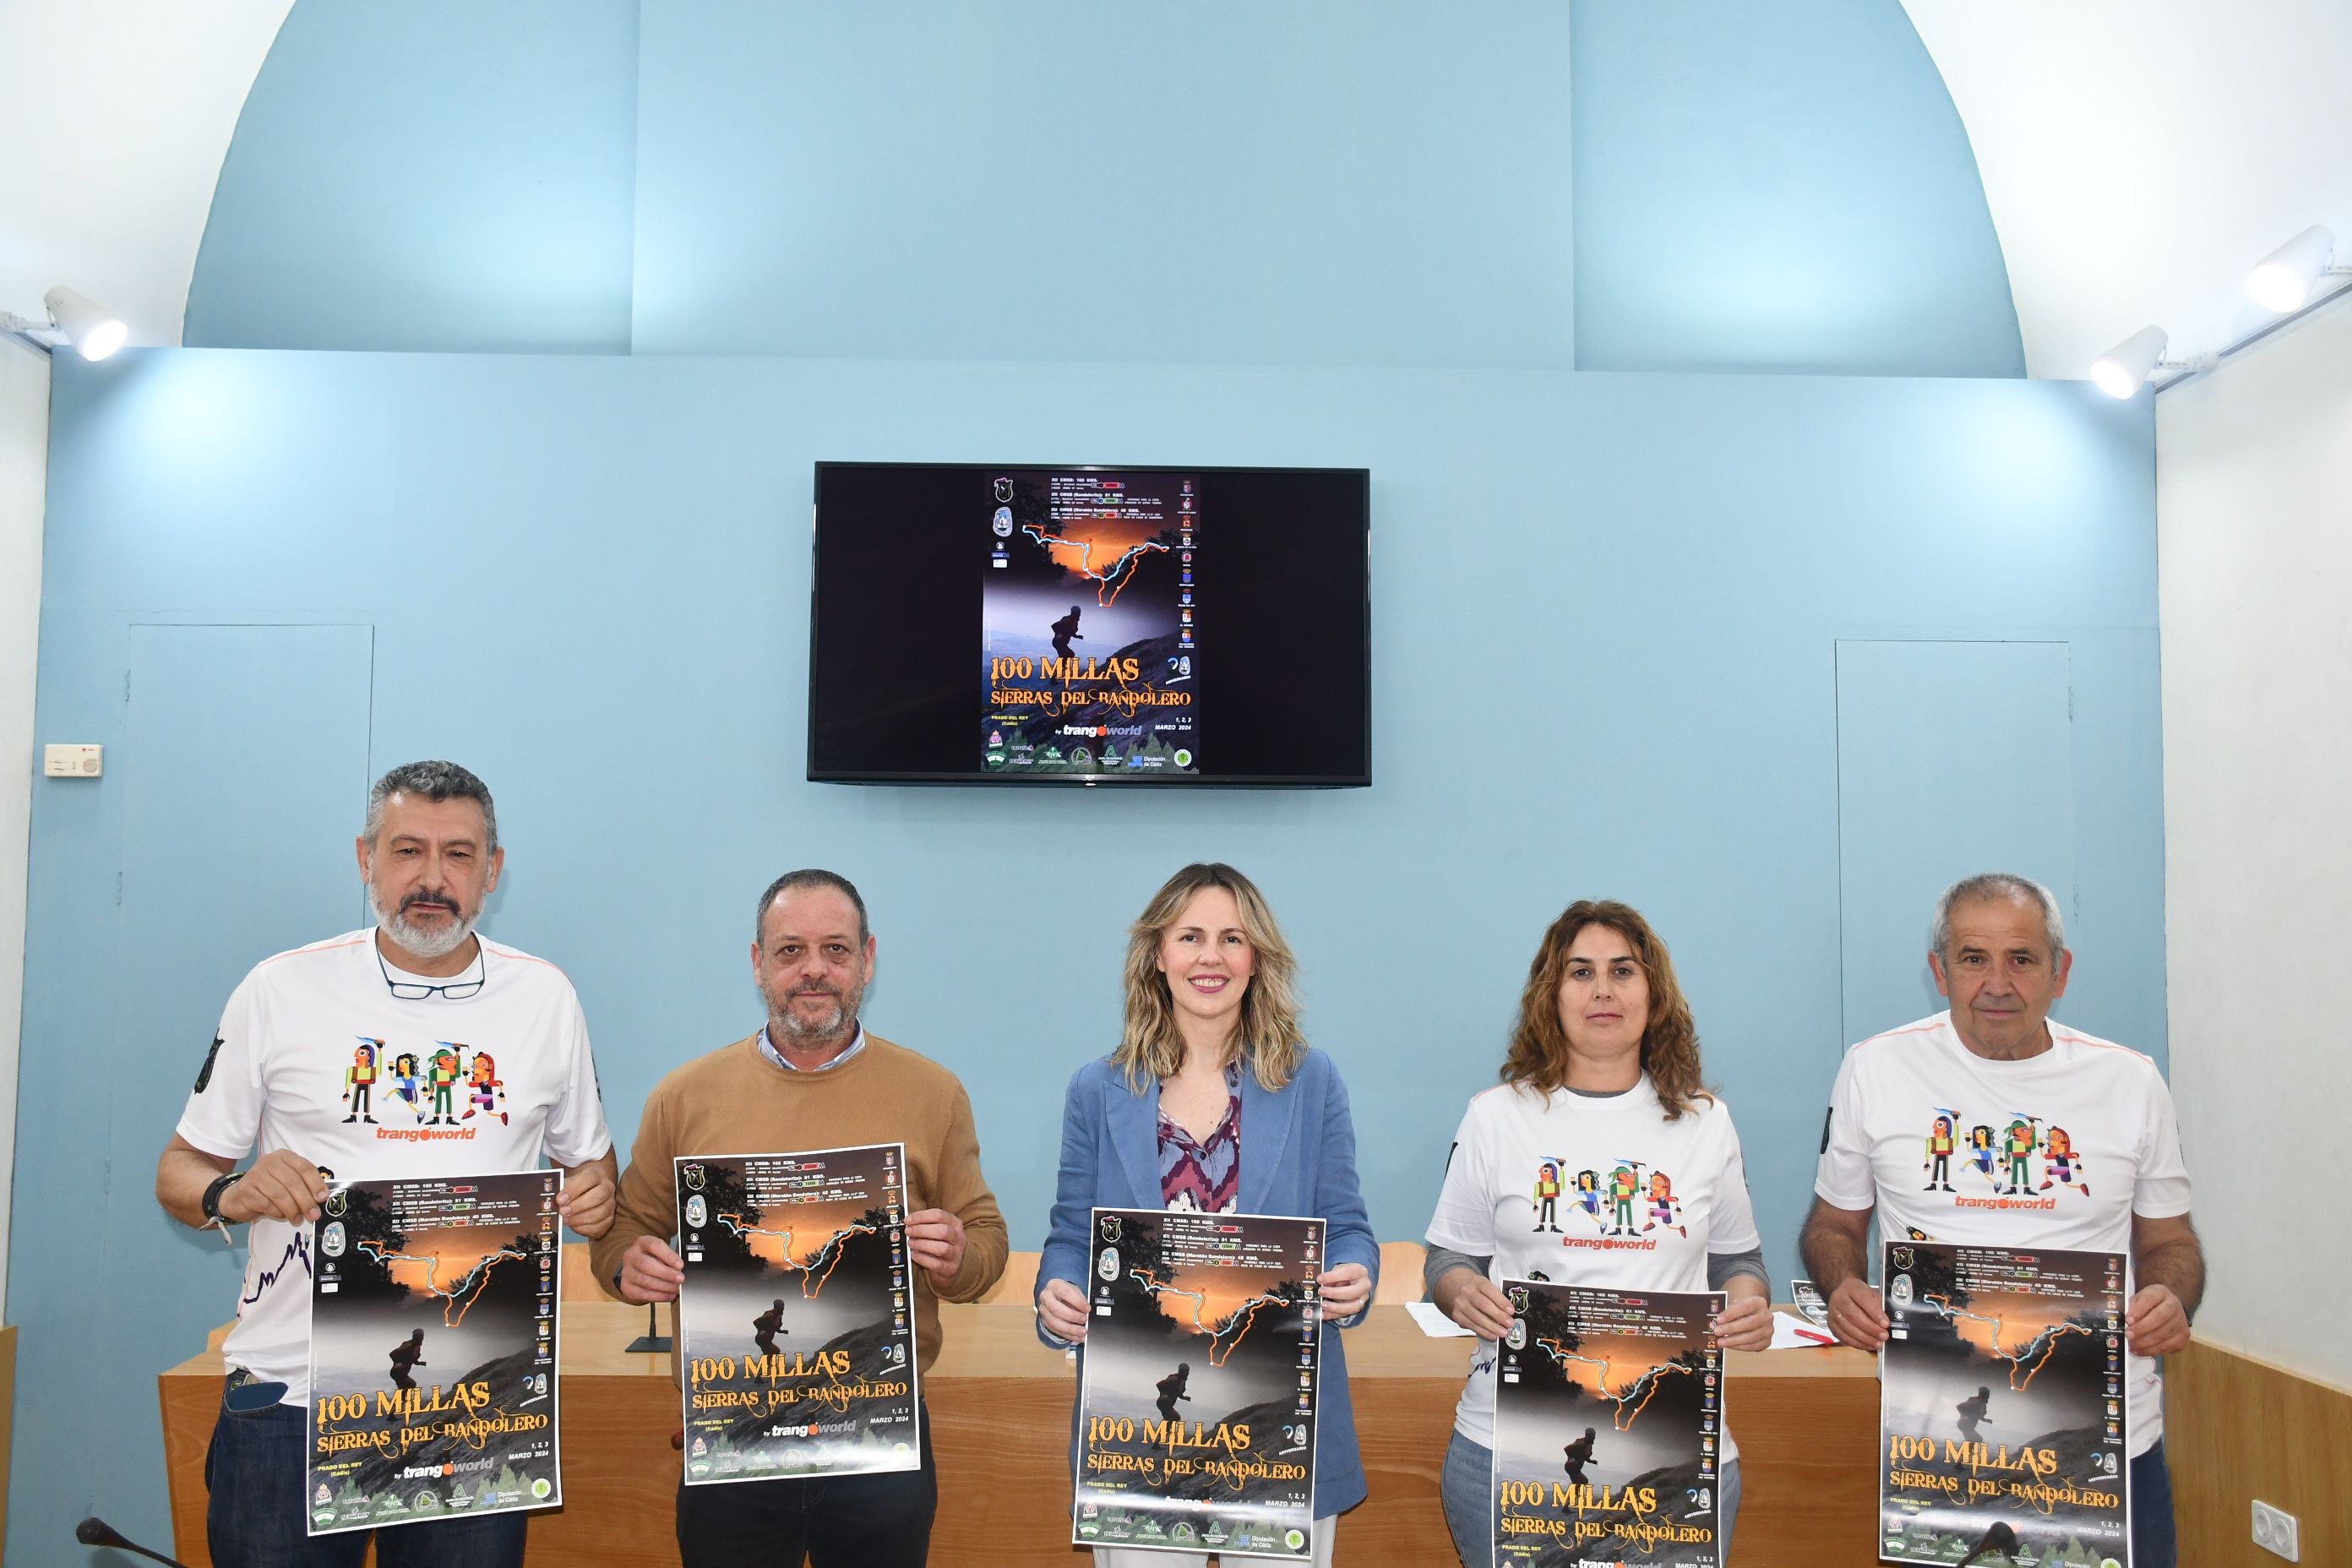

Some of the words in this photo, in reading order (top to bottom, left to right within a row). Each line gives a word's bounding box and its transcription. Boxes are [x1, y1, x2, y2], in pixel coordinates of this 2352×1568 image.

[991, 656, 1033, 679] 100
[1040, 656, 1139, 688] MILLAS
[991, 690, 1055, 712] SIERRAS
[1061, 691, 1090, 710] DEL
[1098, 687, 1191, 712] BANDOLERO
[1063, 725, 1142, 738] trangoworld
[376, 1127, 476, 1142] trangoworld
[1955, 1195, 2056, 1210] trangoworld
[1562, 1236, 1657, 1250] trangoworld
[690, 1356, 736, 1383] 100
[743, 1350, 851, 1387] MILLAS
[317, 1393, 368, 1425] 100
[376, 1381, 490, 1425] MILLAS
[693, 1391, 762, 1415] SIERRAS
[768, 1389, 800, 1412] DEL
[807, 1377, 907, 1407] BANDOLERO
[317, 1430, 395, 1458] SIERRAS
[400, 1426, 435, 1451] DEL
[440, 1409, 548, 1446] BANDOLERO
[771, 1420, 857, 1437] trangoworld
[1088, 1416, 1135, 1442] 100
[1141, 1419, 1250, 1455] MILLAS
[403, 1457, 494, 1479] trangoworld
[508, 1451, 531, 1461] MARZO
[1087, 1454, 1157, 1478] SIERRAS
[1163, 1459, 1196, 1481] DEL
[1204, 1456, 1306, 1486] BANDOLERO
[1890, 1435, 1936, 1462] 100
[1944, 1439, 2058, 1476] MILLAS
[1500, 1480, 1544, 1506] 100
[1551, 1482, 1657, 1518] MILLAS
[1890, 1471, 1961, 1495] SIERRAS
[1968, 1478, 2001, 1500] DEL
[2010, 1480, 2119, 1511] BANDOLERO
[1500, 1517, 1569, 1541] SIERRAS
[1575, 1522, 1605, 1544] DEL
[1614, 1520, 1712, 1549] BANDOLERO
[2076, 1527, 2101, 1535] MARZO
